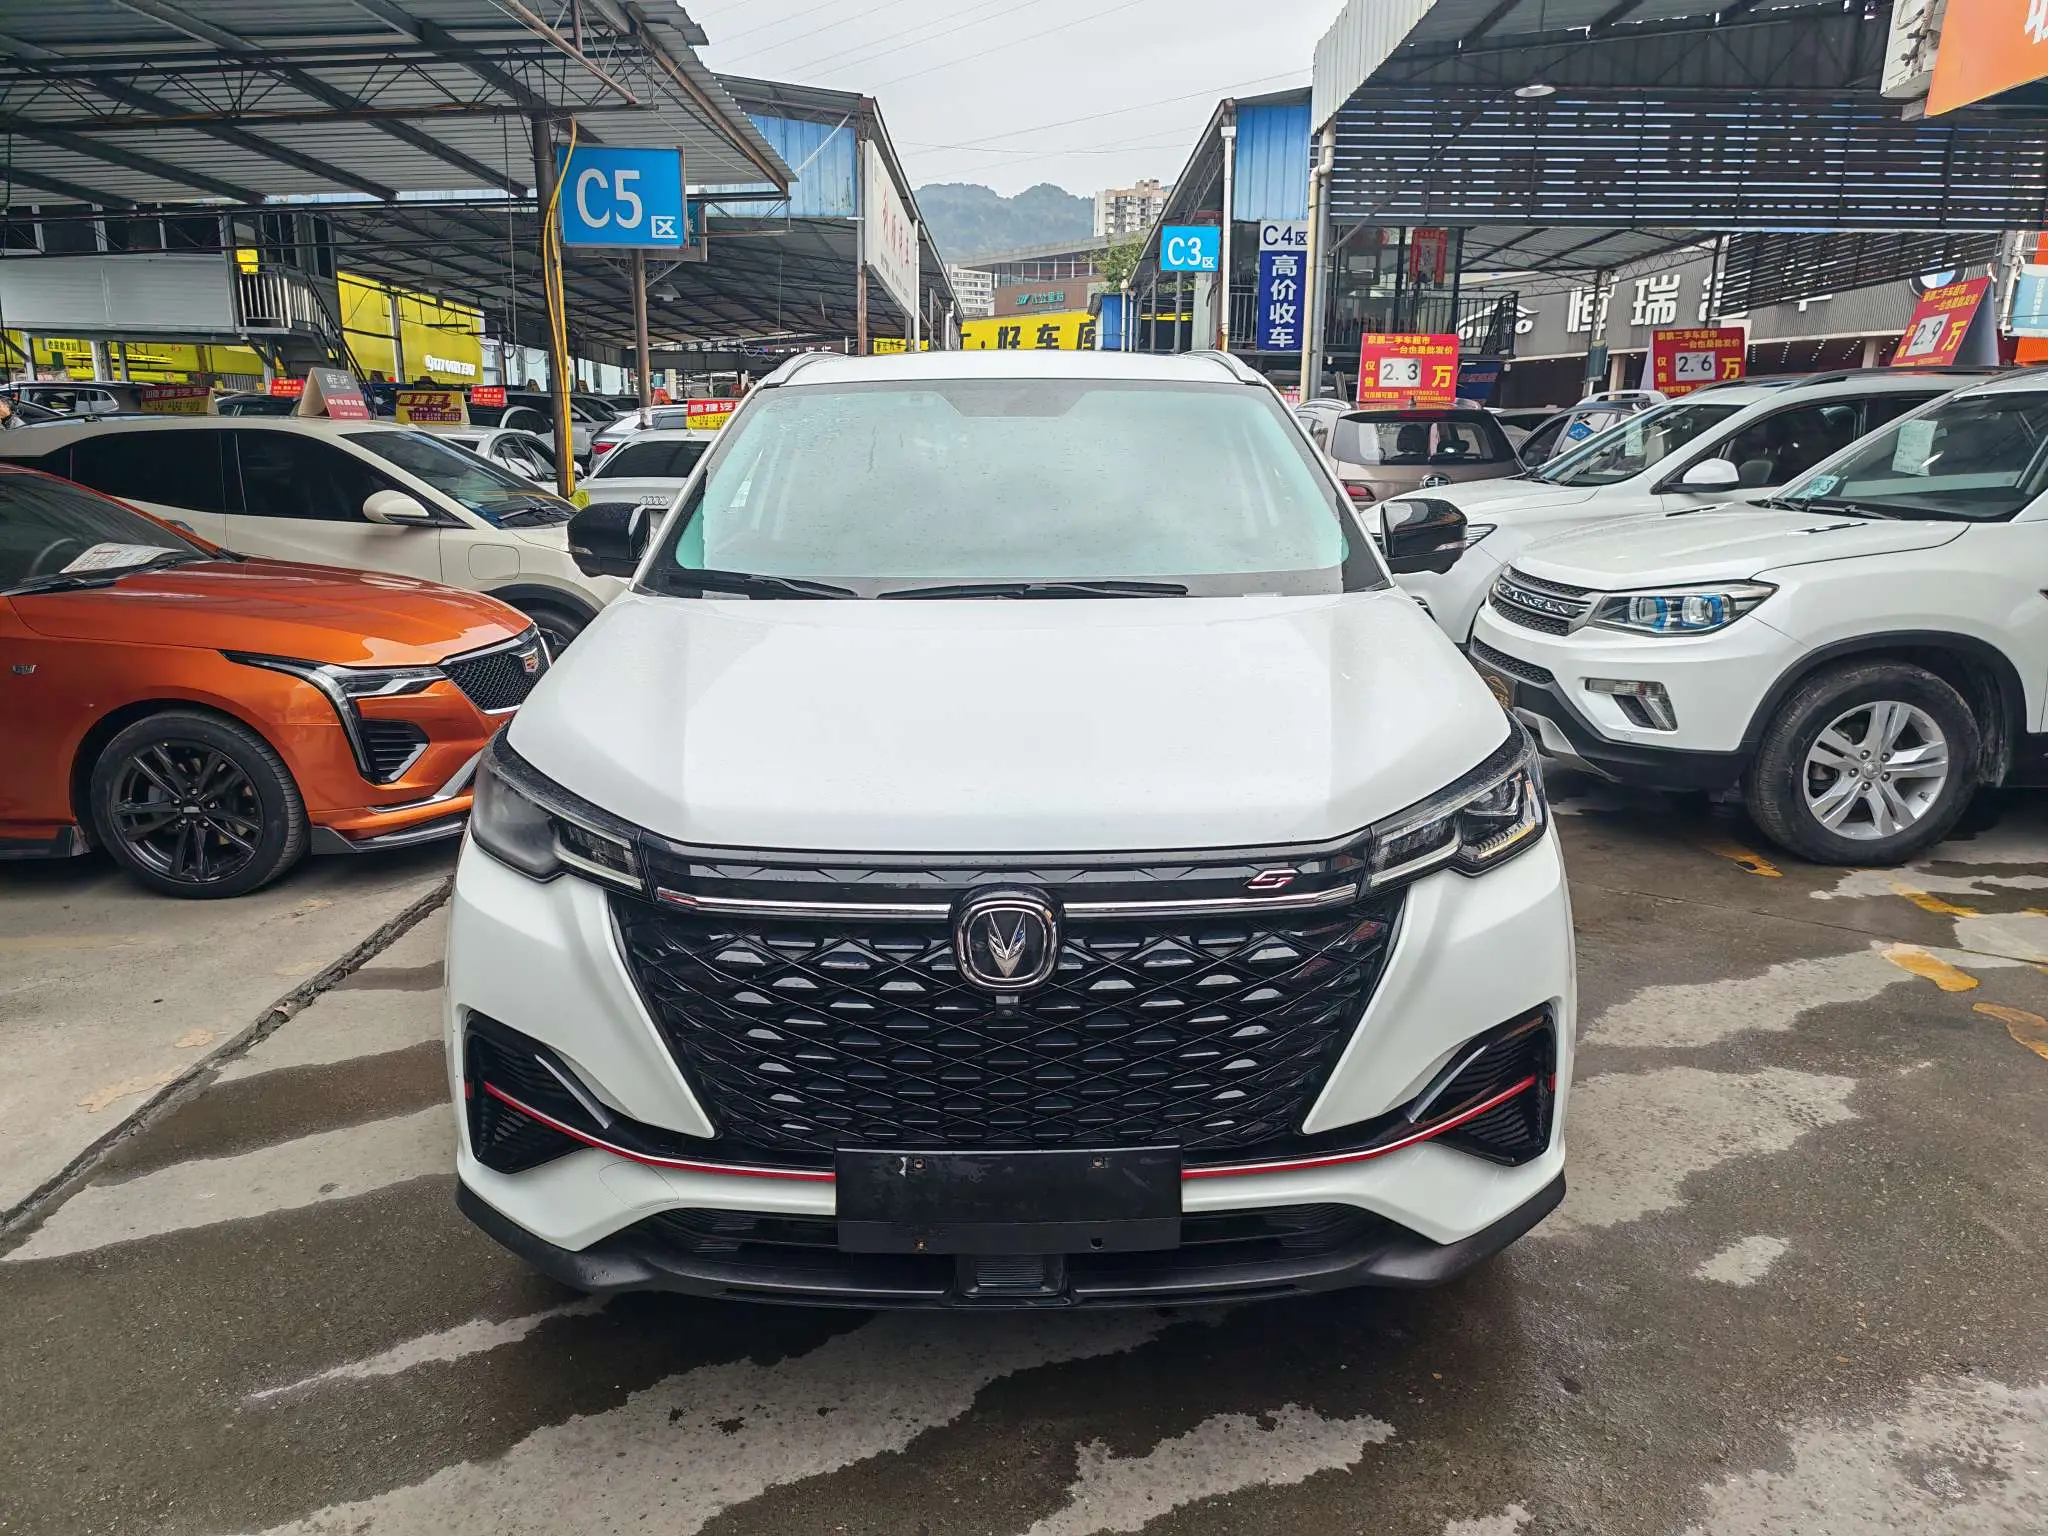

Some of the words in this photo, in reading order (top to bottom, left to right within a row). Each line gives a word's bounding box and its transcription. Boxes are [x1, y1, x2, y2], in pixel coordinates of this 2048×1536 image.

[1268, 254, 1298, 348] 高价收车
[1941, 320, 1968, 351] 万
[1383, 362, 1419, 381] 2.3
[1431, 365, 1454, 388] 万
[1678, 355, 1712, 373] 2.6
[1721, 357, 1742, 379] 万
